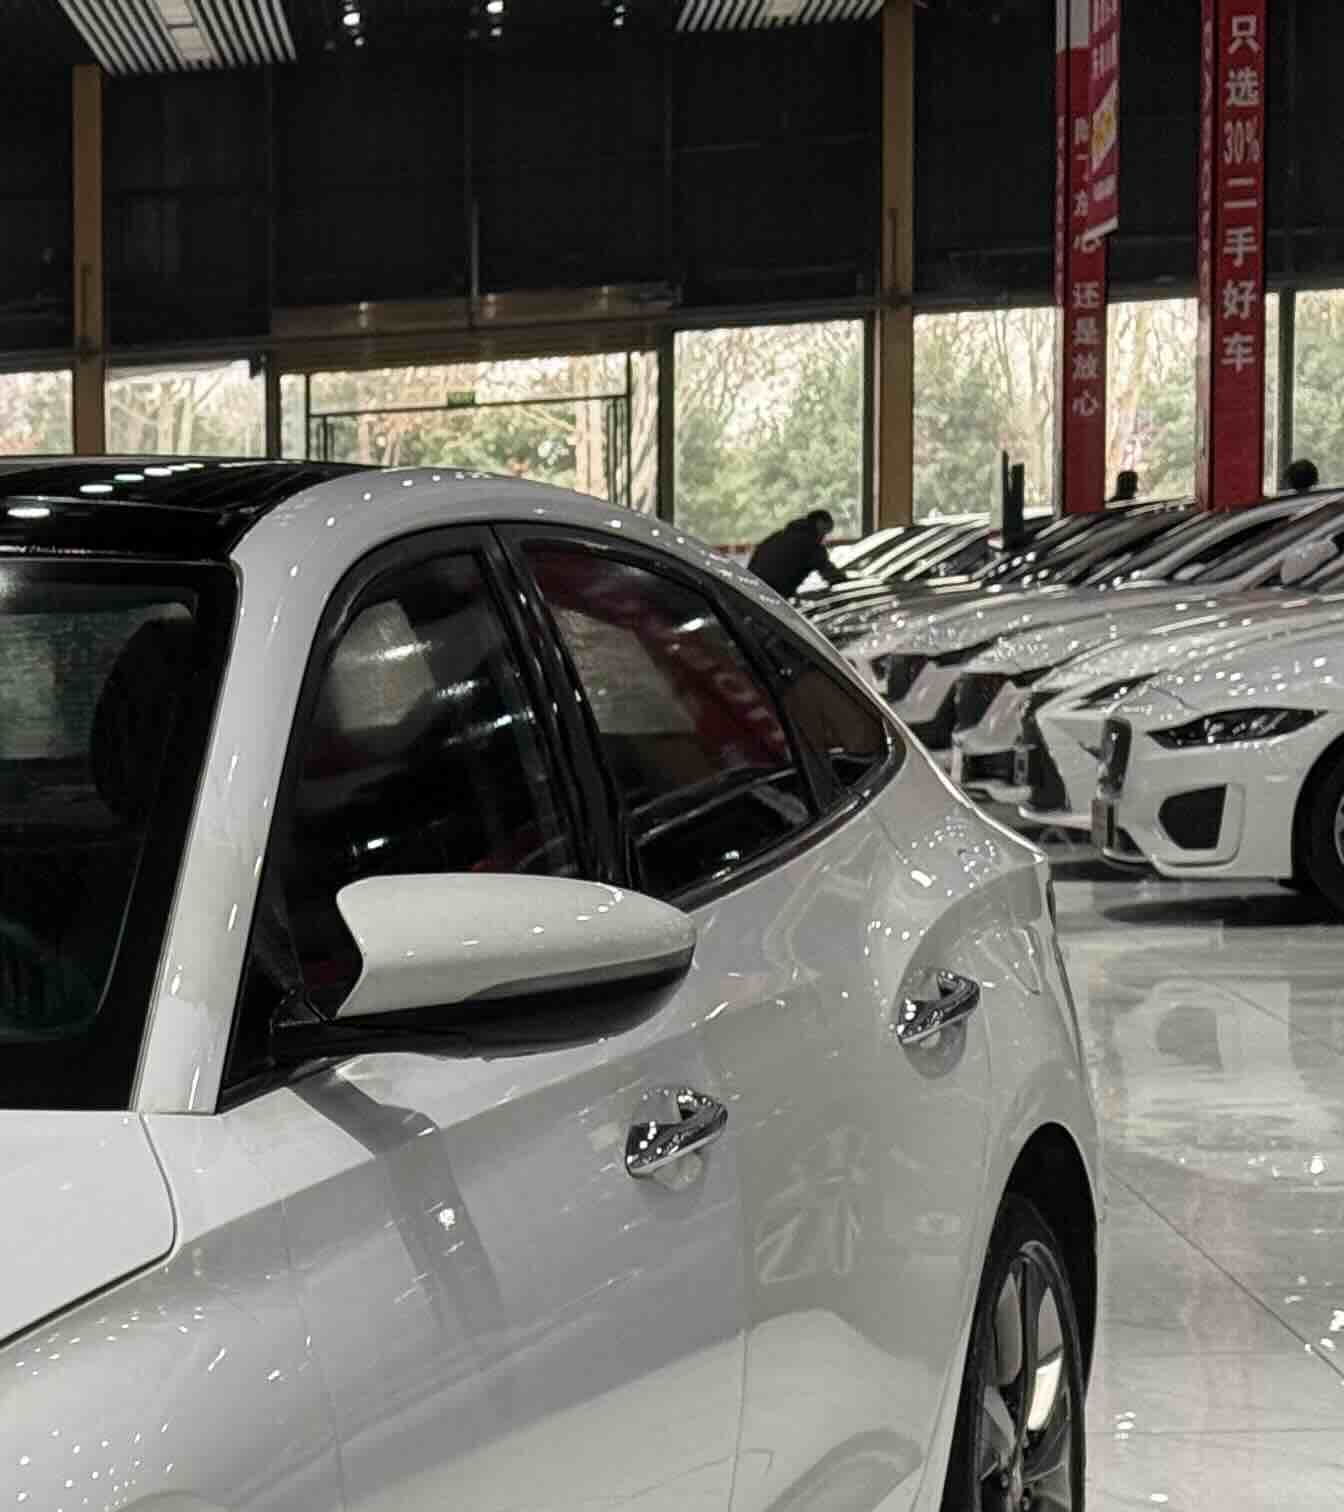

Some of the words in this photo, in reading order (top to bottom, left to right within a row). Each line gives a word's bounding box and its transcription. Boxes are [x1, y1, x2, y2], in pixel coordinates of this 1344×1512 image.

[1221, 15, 1261, 372] 只选30%二手好车
